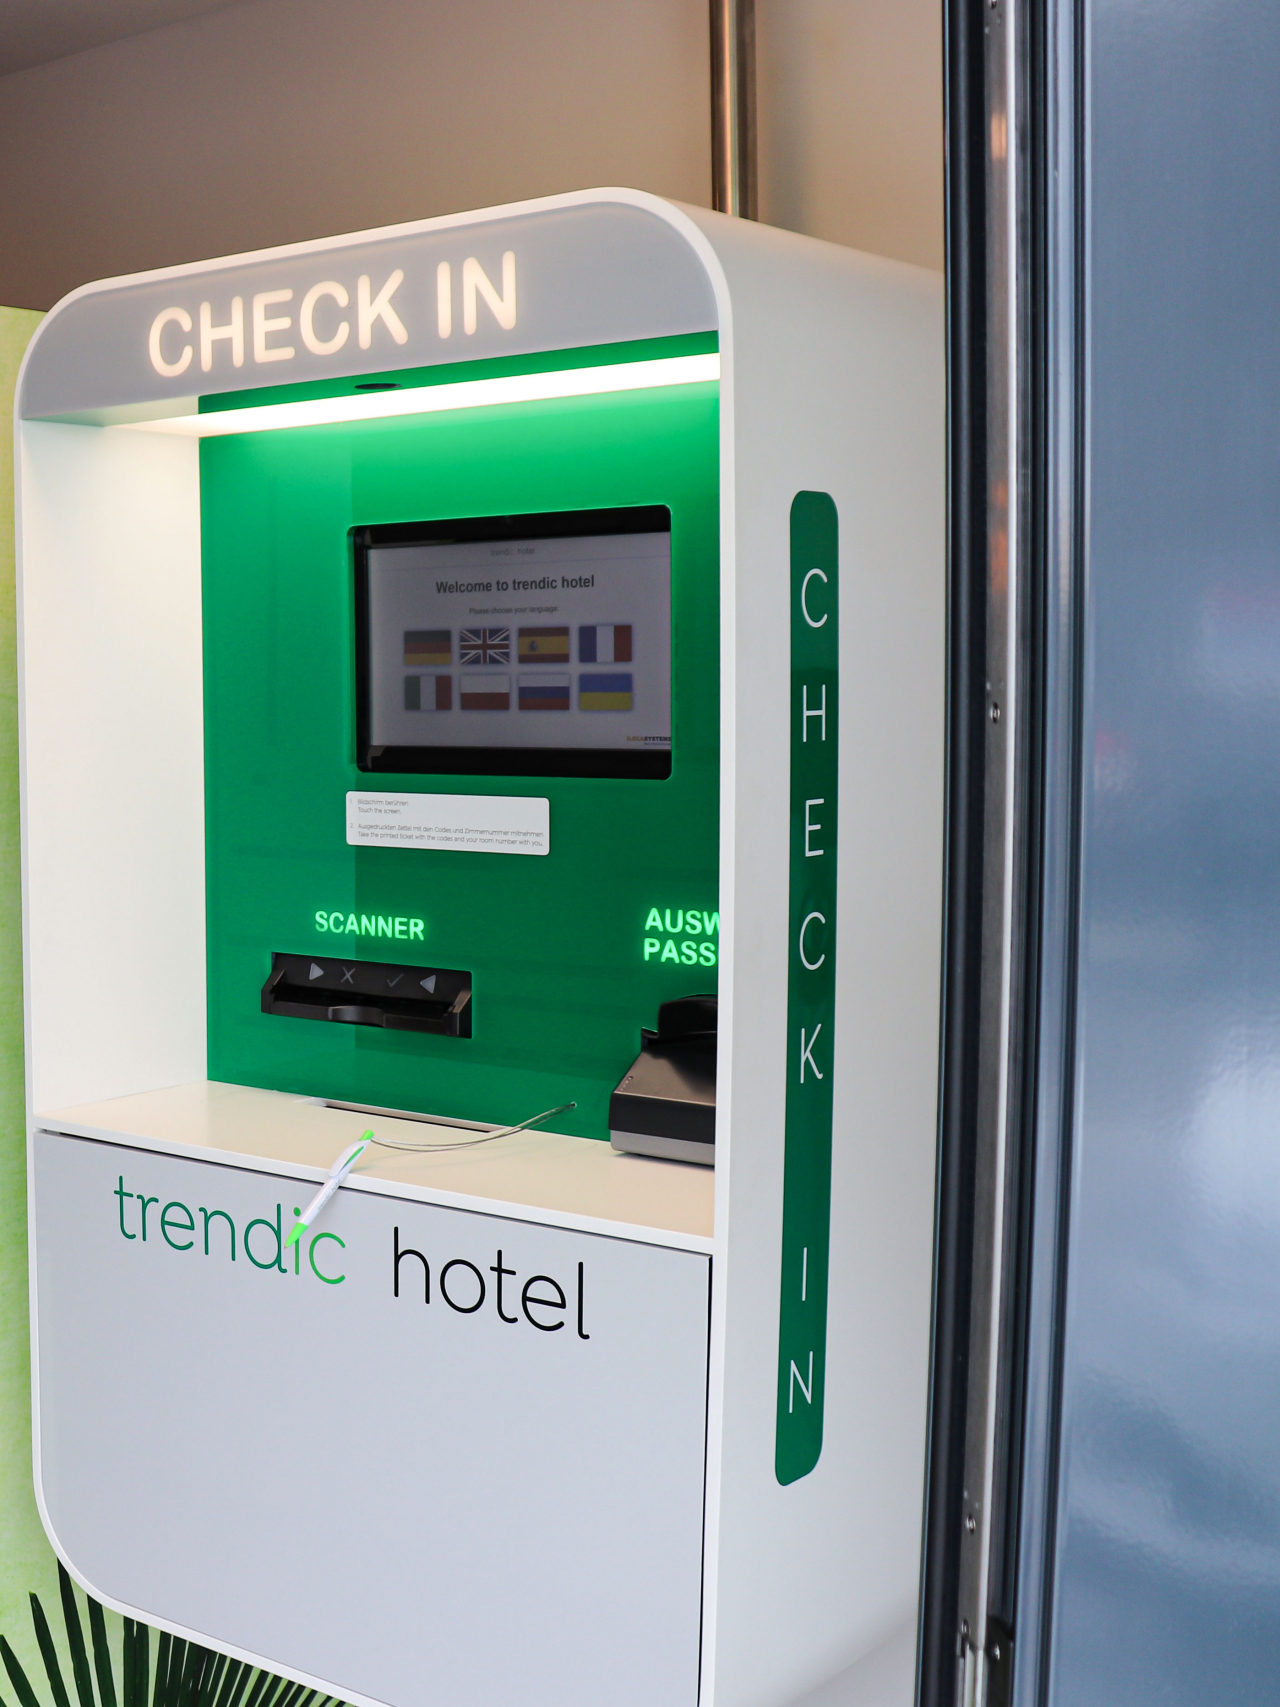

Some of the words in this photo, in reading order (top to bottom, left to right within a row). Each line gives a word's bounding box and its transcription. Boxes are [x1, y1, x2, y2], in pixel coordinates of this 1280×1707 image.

[148, 268, 409, 378] CHECK
[436, 250, 517, 340] IN
[435, 581, 493, 594] Welcome
[496, 579, 509, 592] to
[512, 576, 558, 591] trendic
[561, 574, 595, 589] hotel
[469, 607, 490, 615] Please
[490, 606, 513, 614] choose
[514, 606, 528, 615] your
[357, 823, 396, 831] Ausgedruckten
[434, 826, 452, 834] Codes
[464, 828, 510, 836] Zimmernummer
[380, 832, 398, 840] printed
[314, 910, 425, 941] SCANNER
[644, 907, 719, 936] AUSW
[644, 937, 717, 967] PASS
[113, 1175, 347, 1285] trendic
[393, 1225, 590, 1340] hotel
